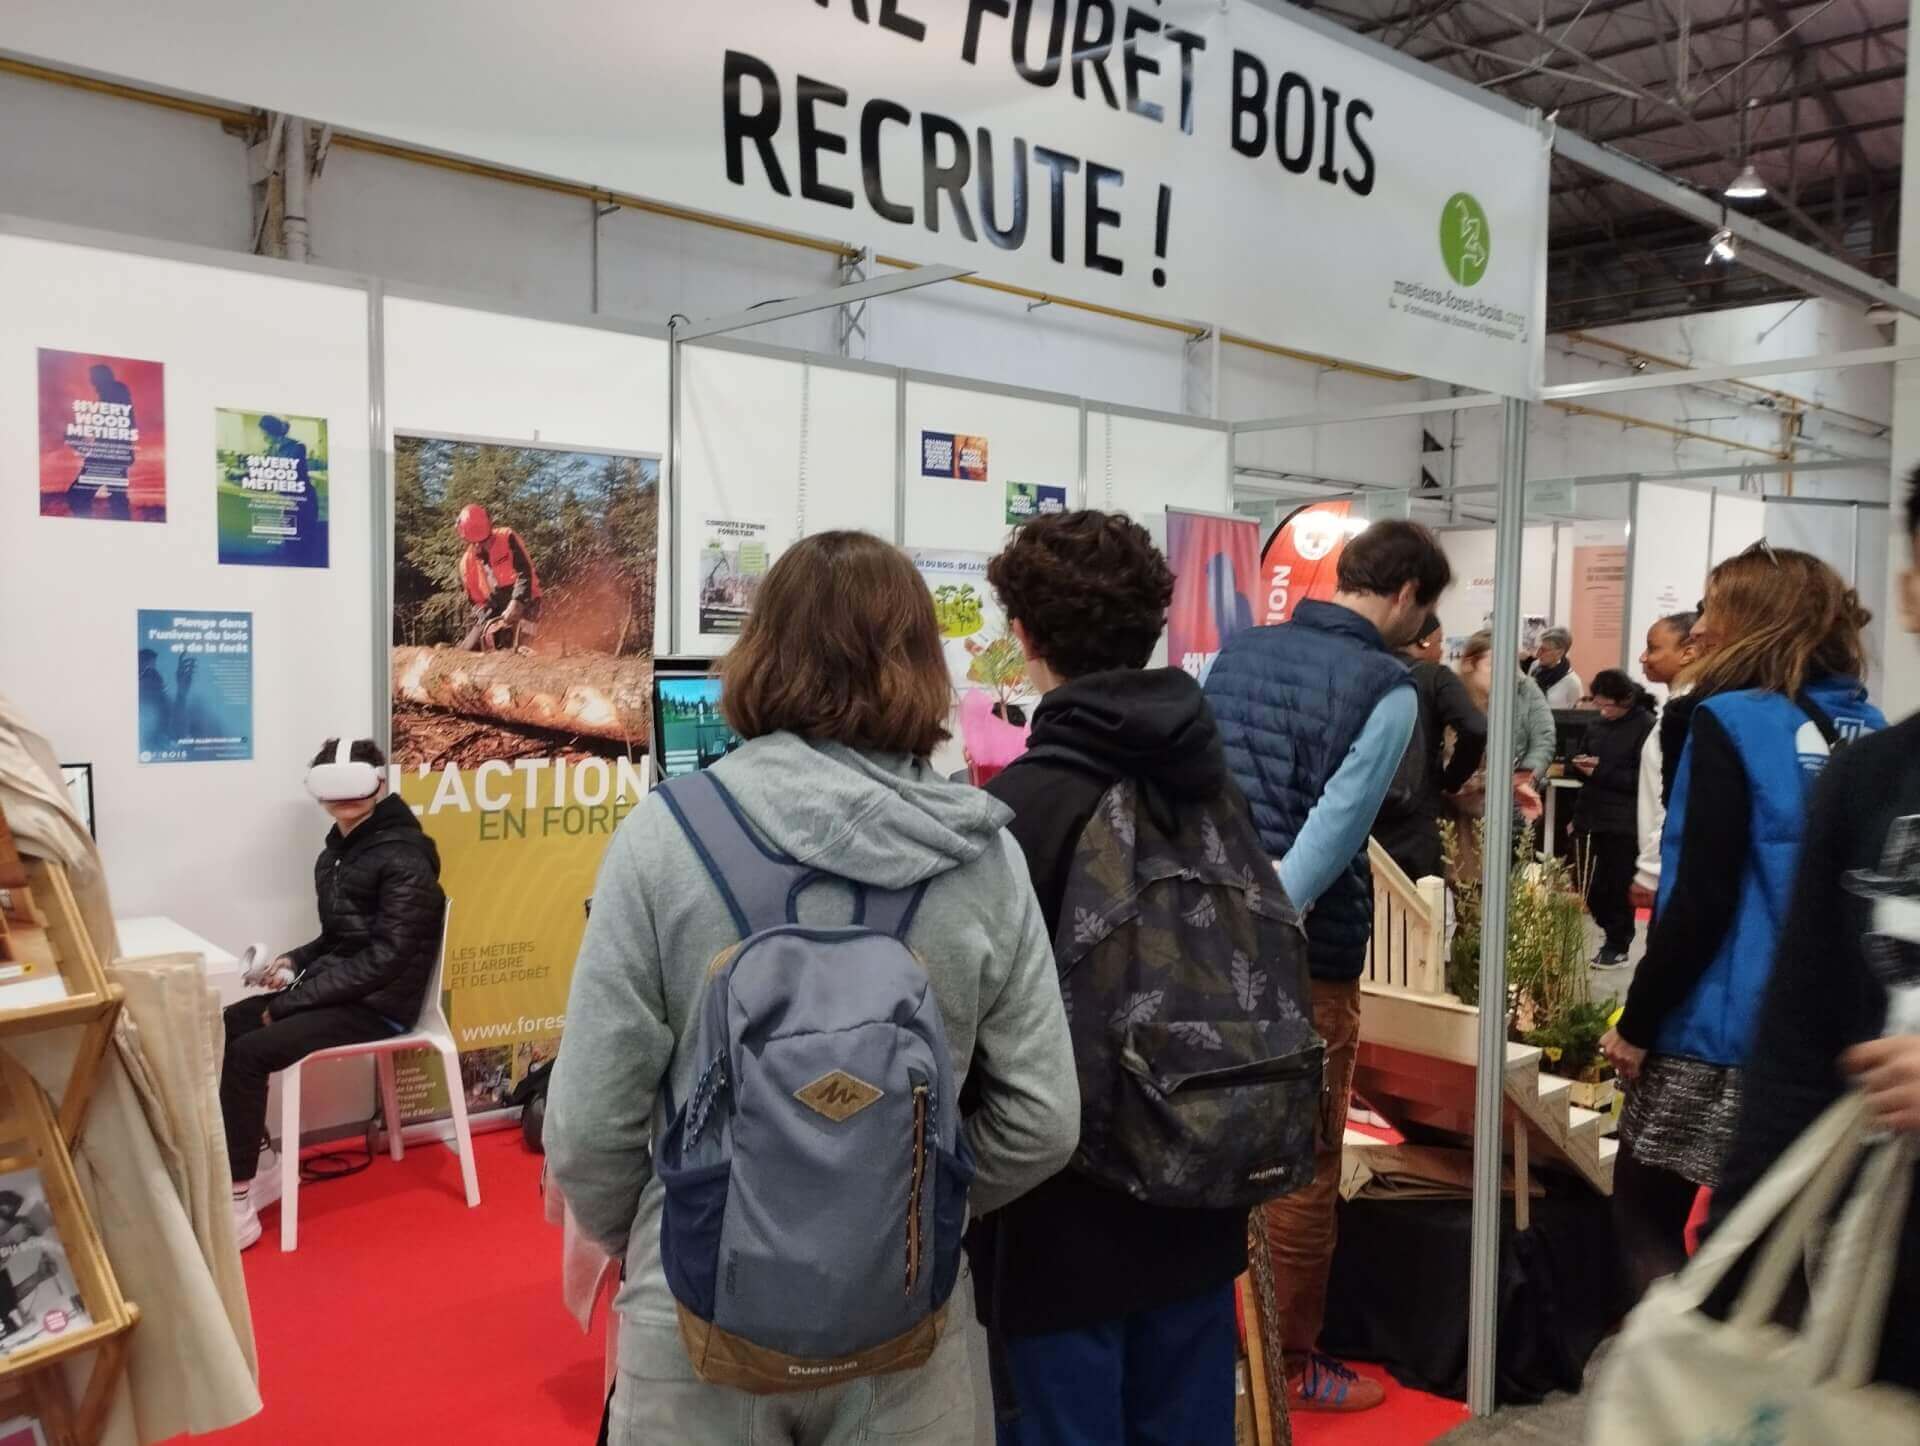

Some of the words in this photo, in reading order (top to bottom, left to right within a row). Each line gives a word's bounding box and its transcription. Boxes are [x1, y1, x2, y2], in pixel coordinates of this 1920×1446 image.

[1231, 49, 1375, 197] BOIS
[723, 50, 1125, 276] RECRUTE
[1153, 183, 1172, 288] !
[72, 400, 132, 416] #VERY
[75, 412, 131, 428] WOOD
[66, 423, 139, 441] METIERS
[246, 455, 300, 470] #VERY
[249, 467, 298, 481] WOOD
[242, 477, 306, 493] METIERS
[1266, 565, 1292, 626] ION
[173, 617, 217, 630] Plonge
[219, 618, 248, 629] dans
[148, 628, 202, 640] l'univers
[203, 630, 221, 641] du
[223, 630, 249, 641] bois
[171, 643, 185, 653] et
[187, 642, 203, 653] de
[205, 643, 217, 653] la
[386, 755, 651, 817] L'ACTION
[480, 809, 526, 841] EN
[543, 794, 638, 837] FORÊ
[452, 947, 477, 961] LES
[451, 961, 469, 976] DE
[472, 955, 525, 973] L'ARBRE
[450, 977, 465, 989] ET
[471, 974, 488, 988] DE
[491, 971, 508, 985] LA
